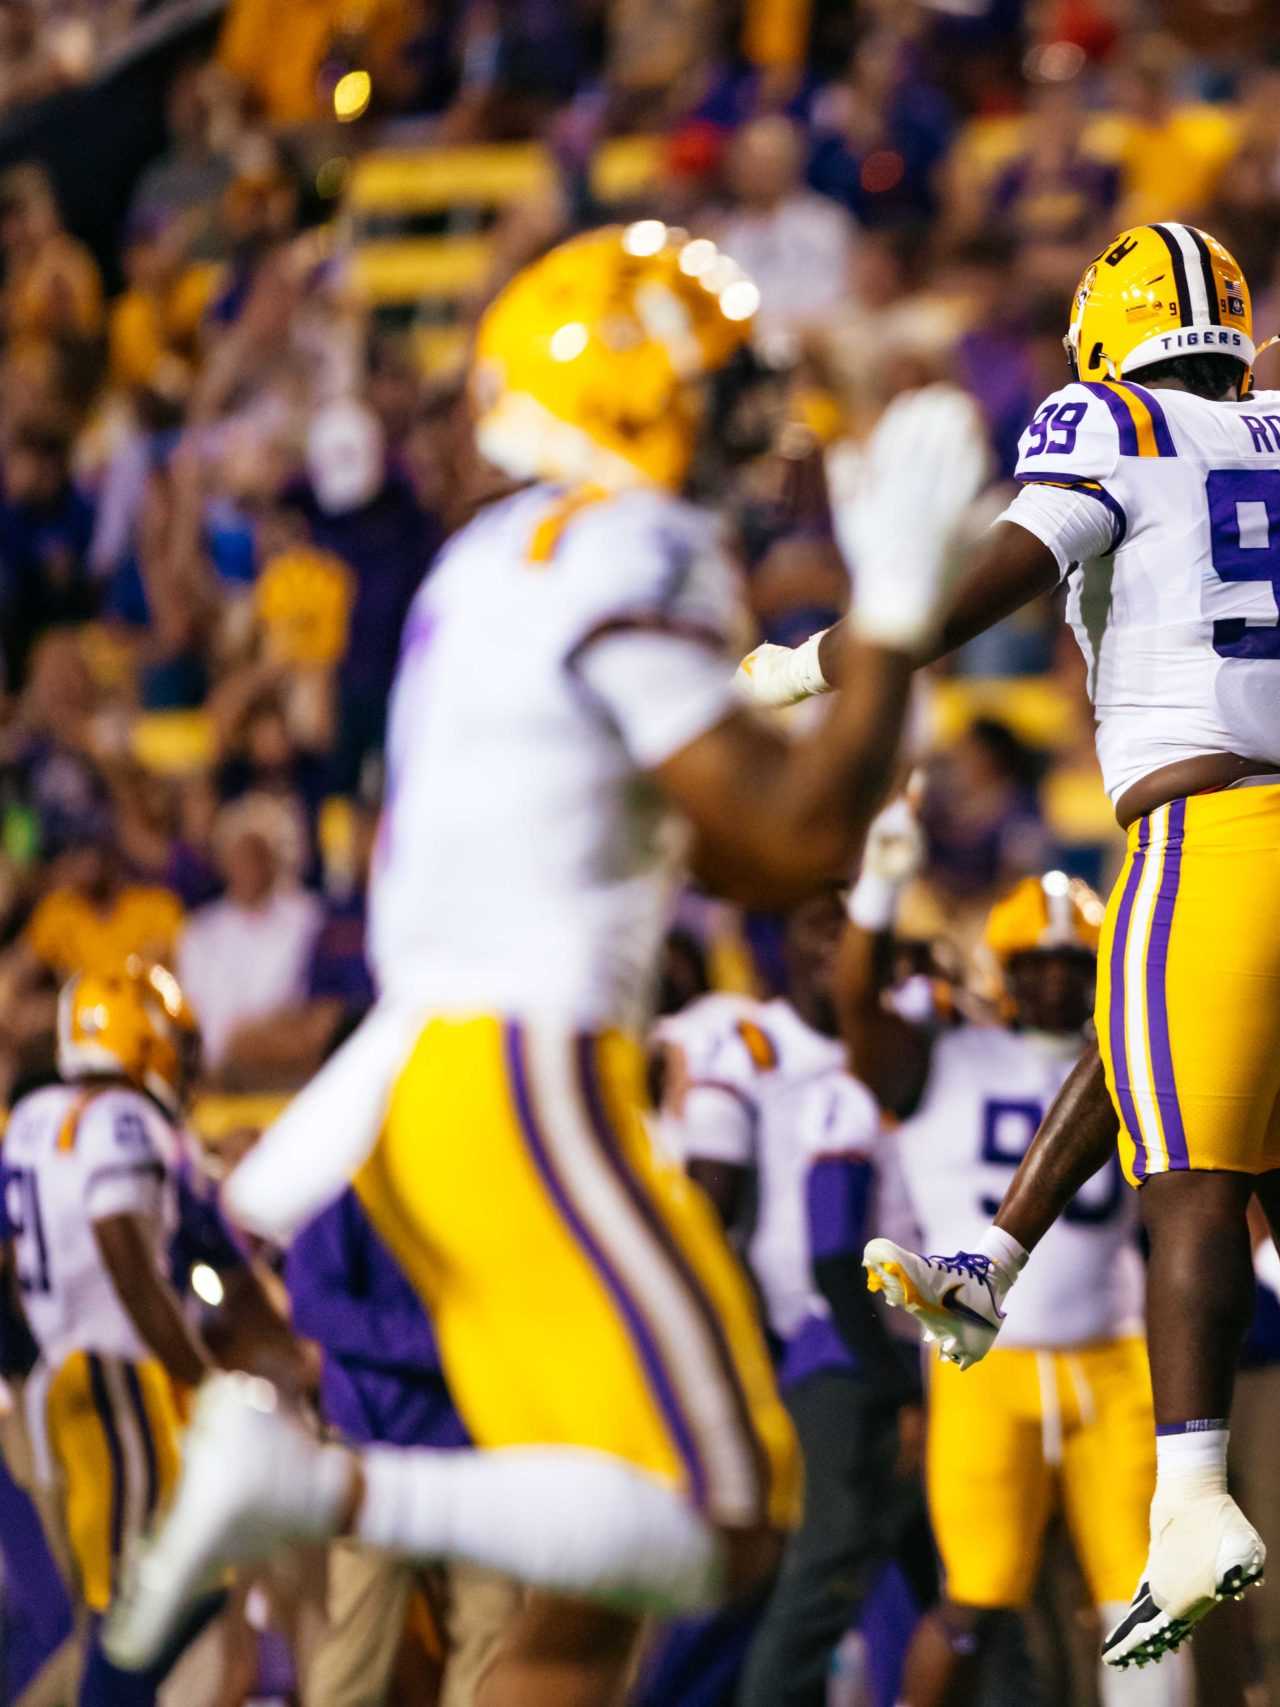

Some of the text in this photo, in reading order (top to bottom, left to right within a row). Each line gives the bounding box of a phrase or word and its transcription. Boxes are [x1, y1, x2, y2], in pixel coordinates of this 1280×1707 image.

[1169, 301, 1178, 316] 9
[1161, 331, 1241, 350] TIGERS
[1025, 402, 1089, 459] 99
